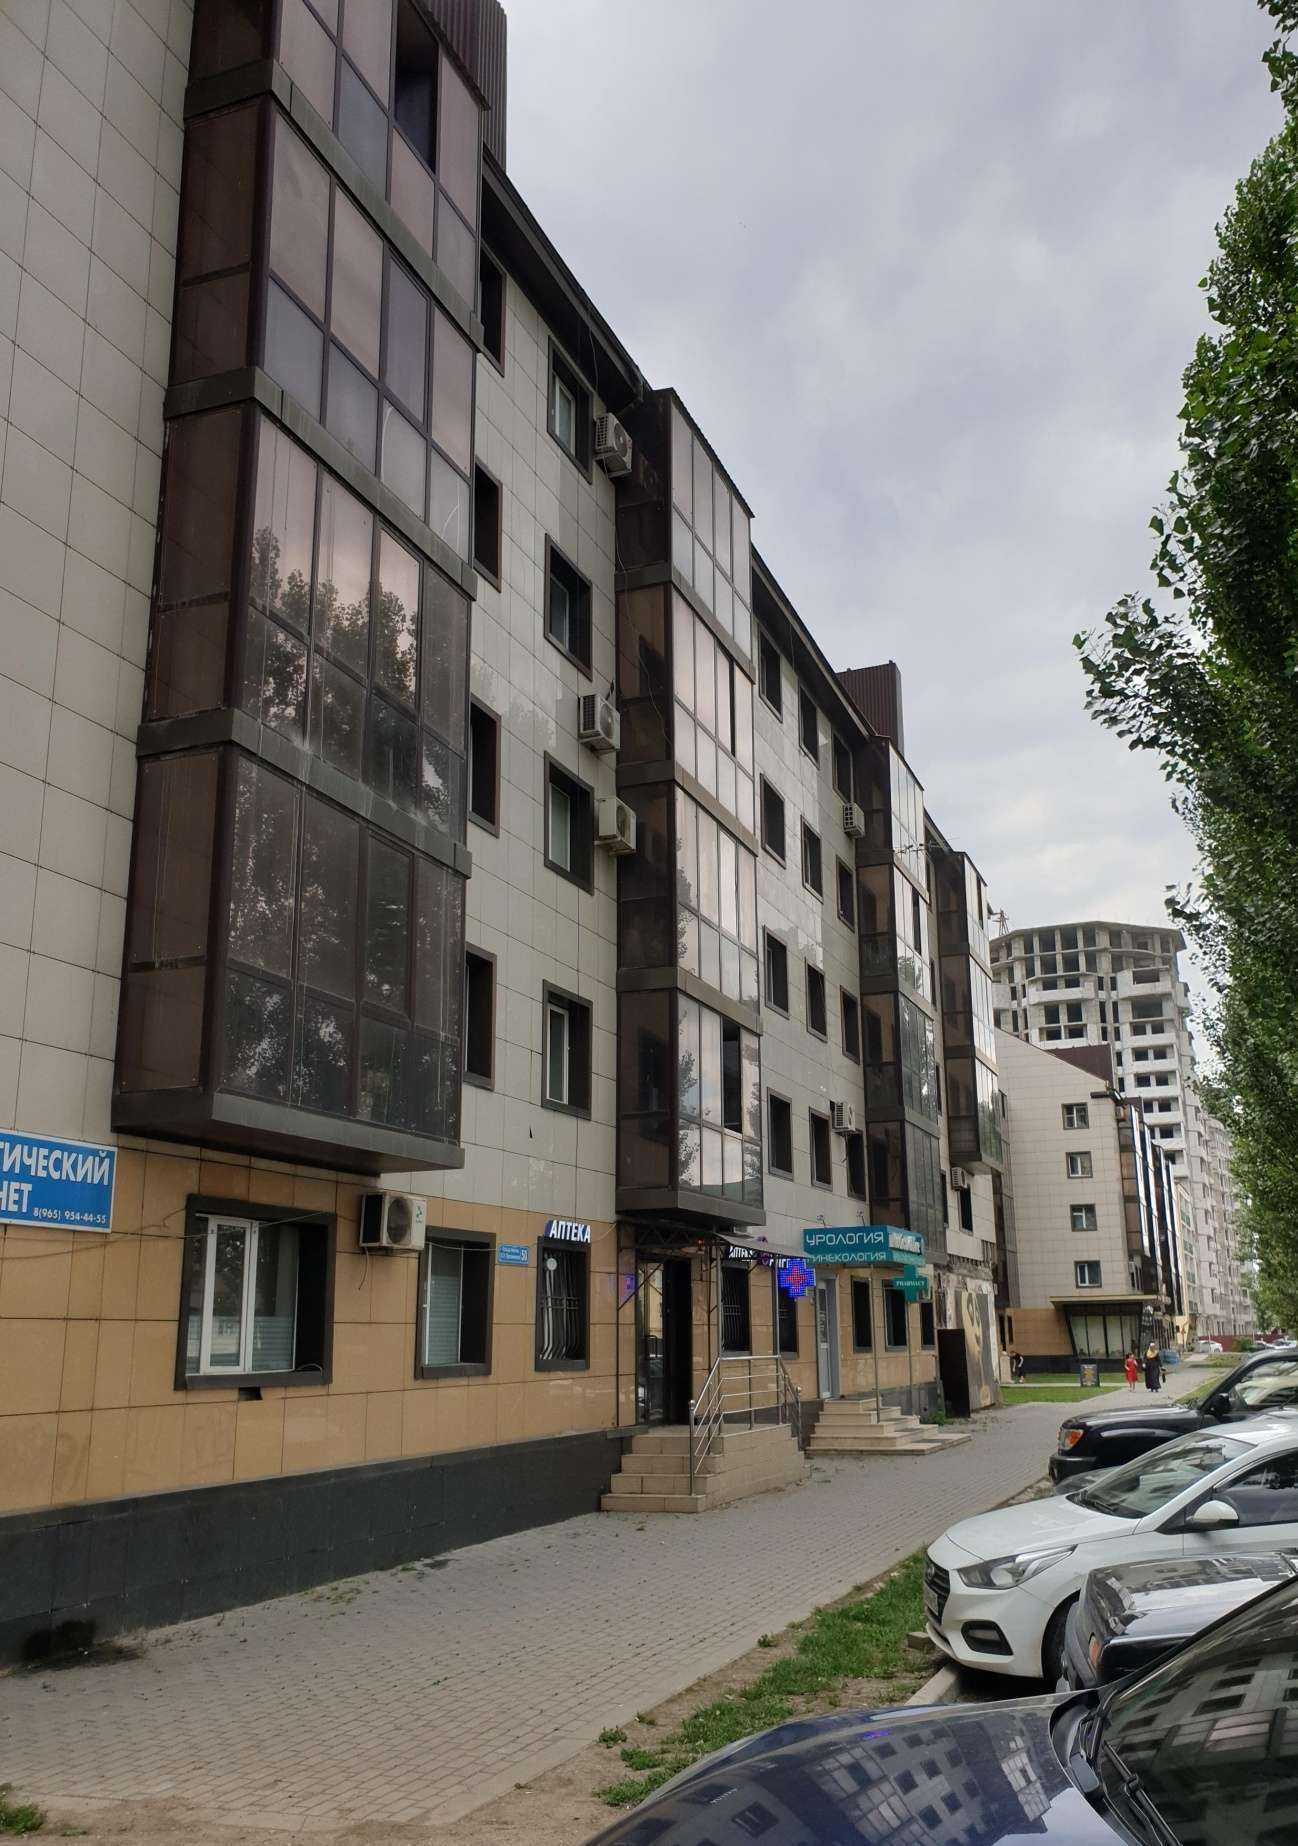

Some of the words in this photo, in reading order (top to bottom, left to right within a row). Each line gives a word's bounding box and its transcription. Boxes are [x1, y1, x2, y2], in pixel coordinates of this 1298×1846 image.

[33, 1207, 61, 1221] 8(965)
[64, 1210, 107, 1224] 954-44-55
[549, 1219, 591, 1243] АПТЕКА
[806, 1231, 884, 1246] УРОЛОГИЯ
